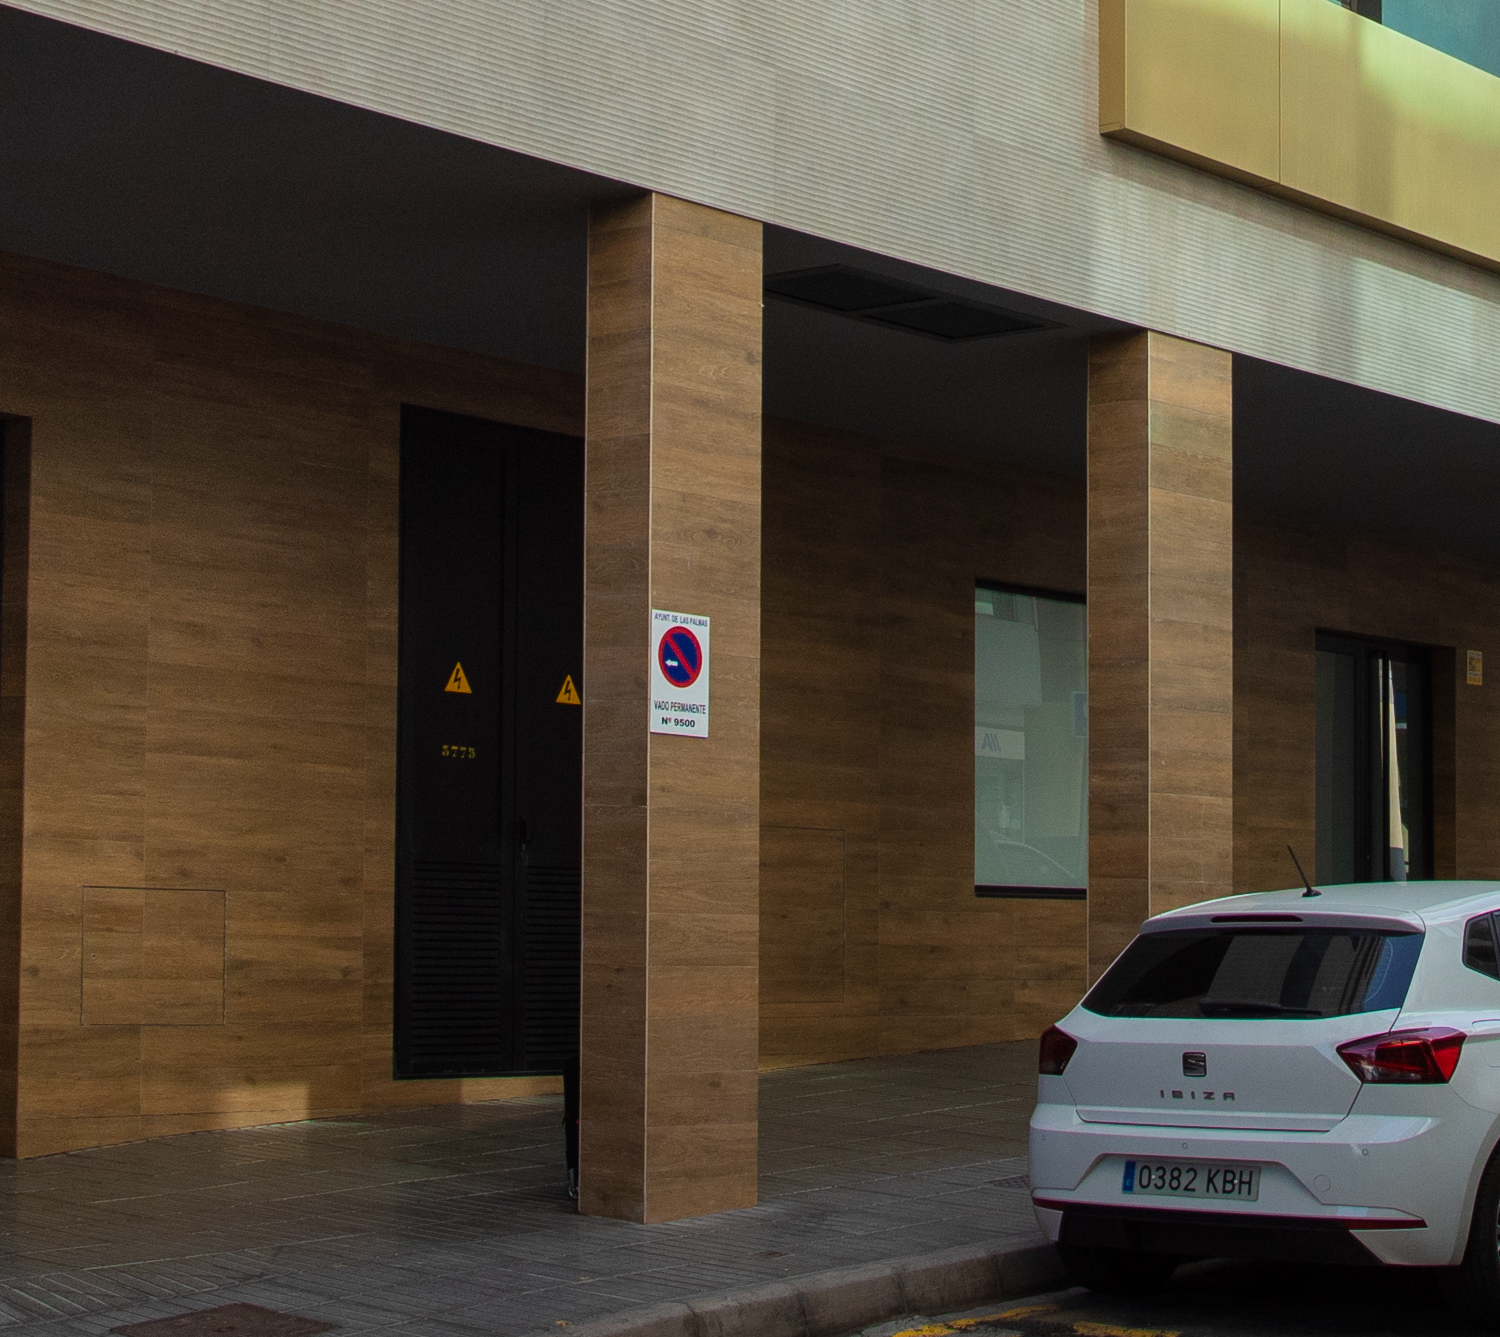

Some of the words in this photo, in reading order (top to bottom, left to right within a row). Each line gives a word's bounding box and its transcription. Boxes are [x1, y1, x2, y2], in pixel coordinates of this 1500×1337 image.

[654, 613, 671, 622] AYUNT.
[672, 615, 679, 623] DE
[680, 616, 689, 624] LAS
[690, 618, 708, 627] PALMAS
[654, 700, 669, 711] VADO
[670, 701, 706, 715] PERMANENTE
[674, 718, 695, 728] 9500
[1160, 1089, 1236, 1101] IBIZA
[1139, 1164, 1198, 1192] 0382
[1206, 1168, 1253, 1196] KBH
